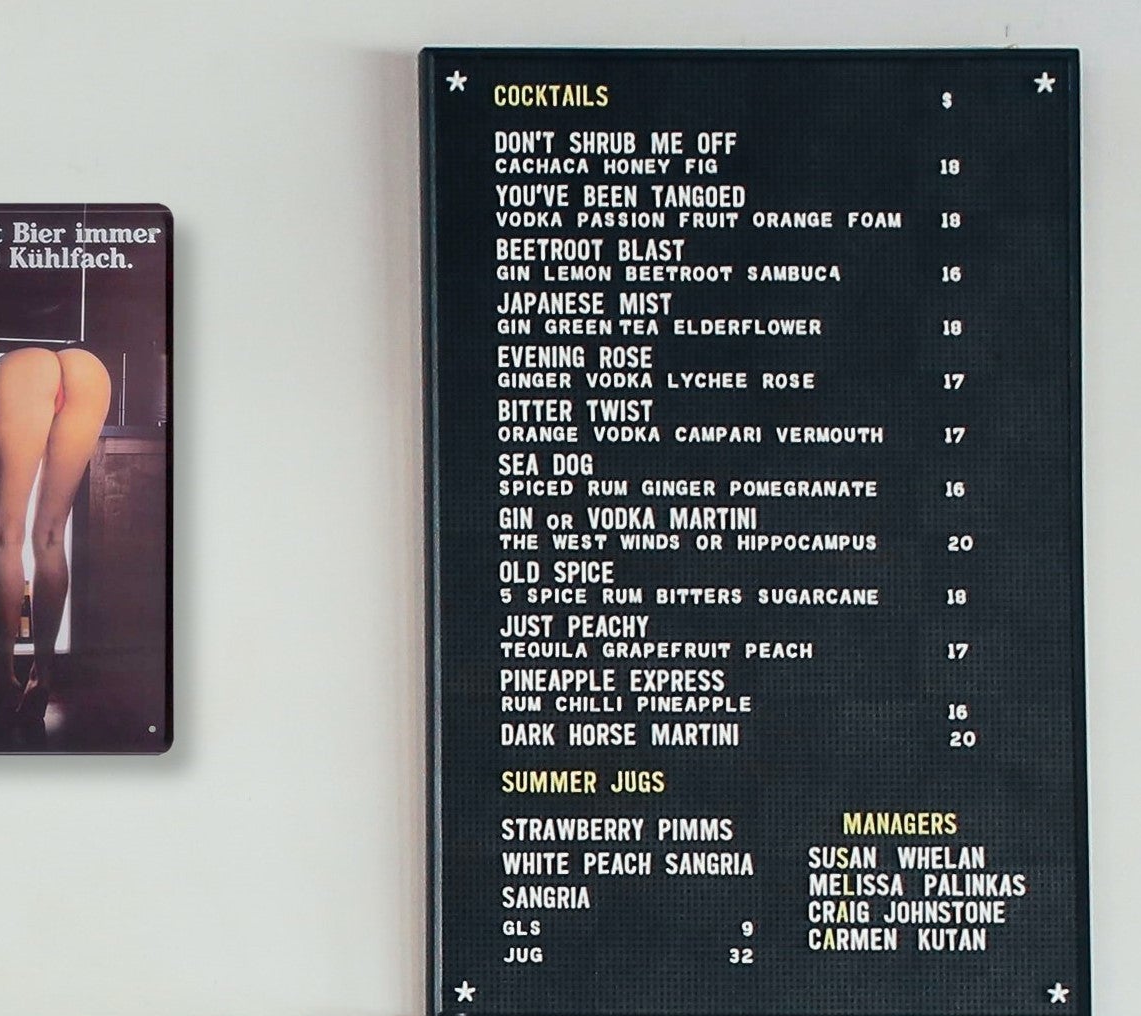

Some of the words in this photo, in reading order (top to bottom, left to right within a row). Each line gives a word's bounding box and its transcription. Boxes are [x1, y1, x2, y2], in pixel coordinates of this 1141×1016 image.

[495, 85, 608, 106] COCKTAILS
[942, 92, 952, 109] $
[495, 131, 554, 153] DON'T
[570, 132, 635, 154] SHRUB
[651, 132, 683, 154] ME
[698, 132, 736, 154] OFF
[496, 158, 588, 174] CACHACA
[604, 159, 670, 174] HONEY
[686, 159, 717, 174] FIG
[941, 159, 959, 175] 18
[496, 184, 568, 207] YOU'VE
[584, 185, 637, 207] BEEN
[651, 185, 745, 208] TANGOED
[496, 212, 562, 227] VODKA
[578, 212, 664, 228] PASSION
[680, 212, 738, 228] FRUIT
[753, 212, 832, 228] ORANGE
[848, 212, 901, 228] FOAM
[942, 213, 960, 228] 18
[13, 222, 66, 243] Bier
[75, 222, 161, 243] immer
[10, 247, 133, 269] Kühlfach.
[497, 239, 603, 261] BEETROOT
[619, 239, 684, 261] BLAST
[497, 265, 529, 281] GIN
[545, 266, 611, 281] LEMON
[626, 266, 732, 281] BEETROOT
[748, 266, 840, 281] SAMBUCA
[942, 266, 961, 282] 16
[497, 292, 604, 314] JAPANESE
[620, 293, 672, 315] MIST
[498, 319, 530, 334] GIN
[545, 319, 612, 335] GREEN
[619, 319, 658, 335] TEA
[674, 319, 821, 335] ELDERFLOWER
[943, 320, 961, 335] 18
[498, 346, 584, 368] EVENING
[600, 346, 652, 369] ROSE
[498, 373, 571, 388] GINGER
[586, 373, 652, 388] VODKA
[668, 373, 747, 388] LYCHEE
[763, 373, 814, 389] ROSE
[944, 374, 964, 389] 17
[499, 400, 572, 422] BITTER
[586, 400, 653, 422] TWIST
[498, 426, 578, 442] ORANGE
[594, 426, 660, 442] VODKA
[675, 427, 761, 442] CAMPARI
[776, 427, 883, 443] VERMOUTH
[945, 428, 965, 443] 17
[499, 453, 538, 476] SEA
[553, 454, 593, 475] DOG
[500, 480, 573, 496] SPICED
[588, 480, 627, 496] RUM
[642, 480, 715, 496] GINGER
[730, 481, 877, 497] POMEGRANATE
[946, 481, 964, 497] 16
[500, 507, 532, 529] GIN
[547, 514, 573, 530] OR
[587, 507, 655, 529] VODKA
[670, 507, 756, 530] MARTINI
[500, 534, 538, 550] THE
[553, 534, 607, 550] WEST
[620, 534, 679, 550] WINDS
[696, 535, 722, 550] OR
[738, 535, 876, 551] HIPPOCAMPUS
[948, 536, 973, 551] 20
[500, 561, 539, 583] OLD
[554, 561, 614, 583] SPICE
[500, 588, 511, 603] 5
[528, 588, 586, 604] SPICE
[603, 588, 642, 604] RUM
[657, 588, 742, 604] BITTERS
[759, 589, 878, 605] SUGARCANE
[948, 589, 966, 605] 18
[500, 615, 553, 637] JUST
[568, 615, 648, 638] PEACHY
[501, 642, 587, 658] TEQUILA
[603, 642, 730, 658] GRAPEFRUIT
[746, 643, 812, 658] PEACH
[948, 643, 968, 659] 17
[501, 669, 615, 692] PINEAPPLE
[631, 670, 724, 692] EXPRESS
[502, 696, 541, 711] RUM
[556, 696, 622, 712] CHILLI
[638, 696, 751, 712] PINEAPPLE
[948, 704, 967, 720] 16
[502, 723, 555, 746] DARK
[570, 723, 636, 746] HORSE
[652, 723, 738, 746] MARTINI
[950, 731, 976, 747] 20
[502, 771, 596, 793] SUMMER
[611, 771, 664, 792] JUGS
[502, 818, 643, 841] STRAWBERRY
[659, 818, 733, 841] PIMMS
[844, 813, 957, 835] MANAGERS
[503, 852, 569, 875] WHITE
[584, 852, 651, 875] PEACH
[665, 853, 753, 875] SANGRIA
[809, 846, 876, 869] SUSAN
[898, 846, 984, 869] WHELAN
[810, 873, 903, 896] MELISSA
[925, 874, 1026, 897] PALINKAS
[503, 886, 590, 909] SANGRIA
[809, 901, 869, 923] CRAIG
[884, 901, 1005, 924] JOHNSTONE
[503, 921, 540, 935] GLS
[742, 921, 753, 936] 9
[809, 928, 897, 950] CARMEN
[918, 928, 986, 951] KUTAN
[504, 947, 542, 963] JUG
[730, 948, 753, 963] 32
